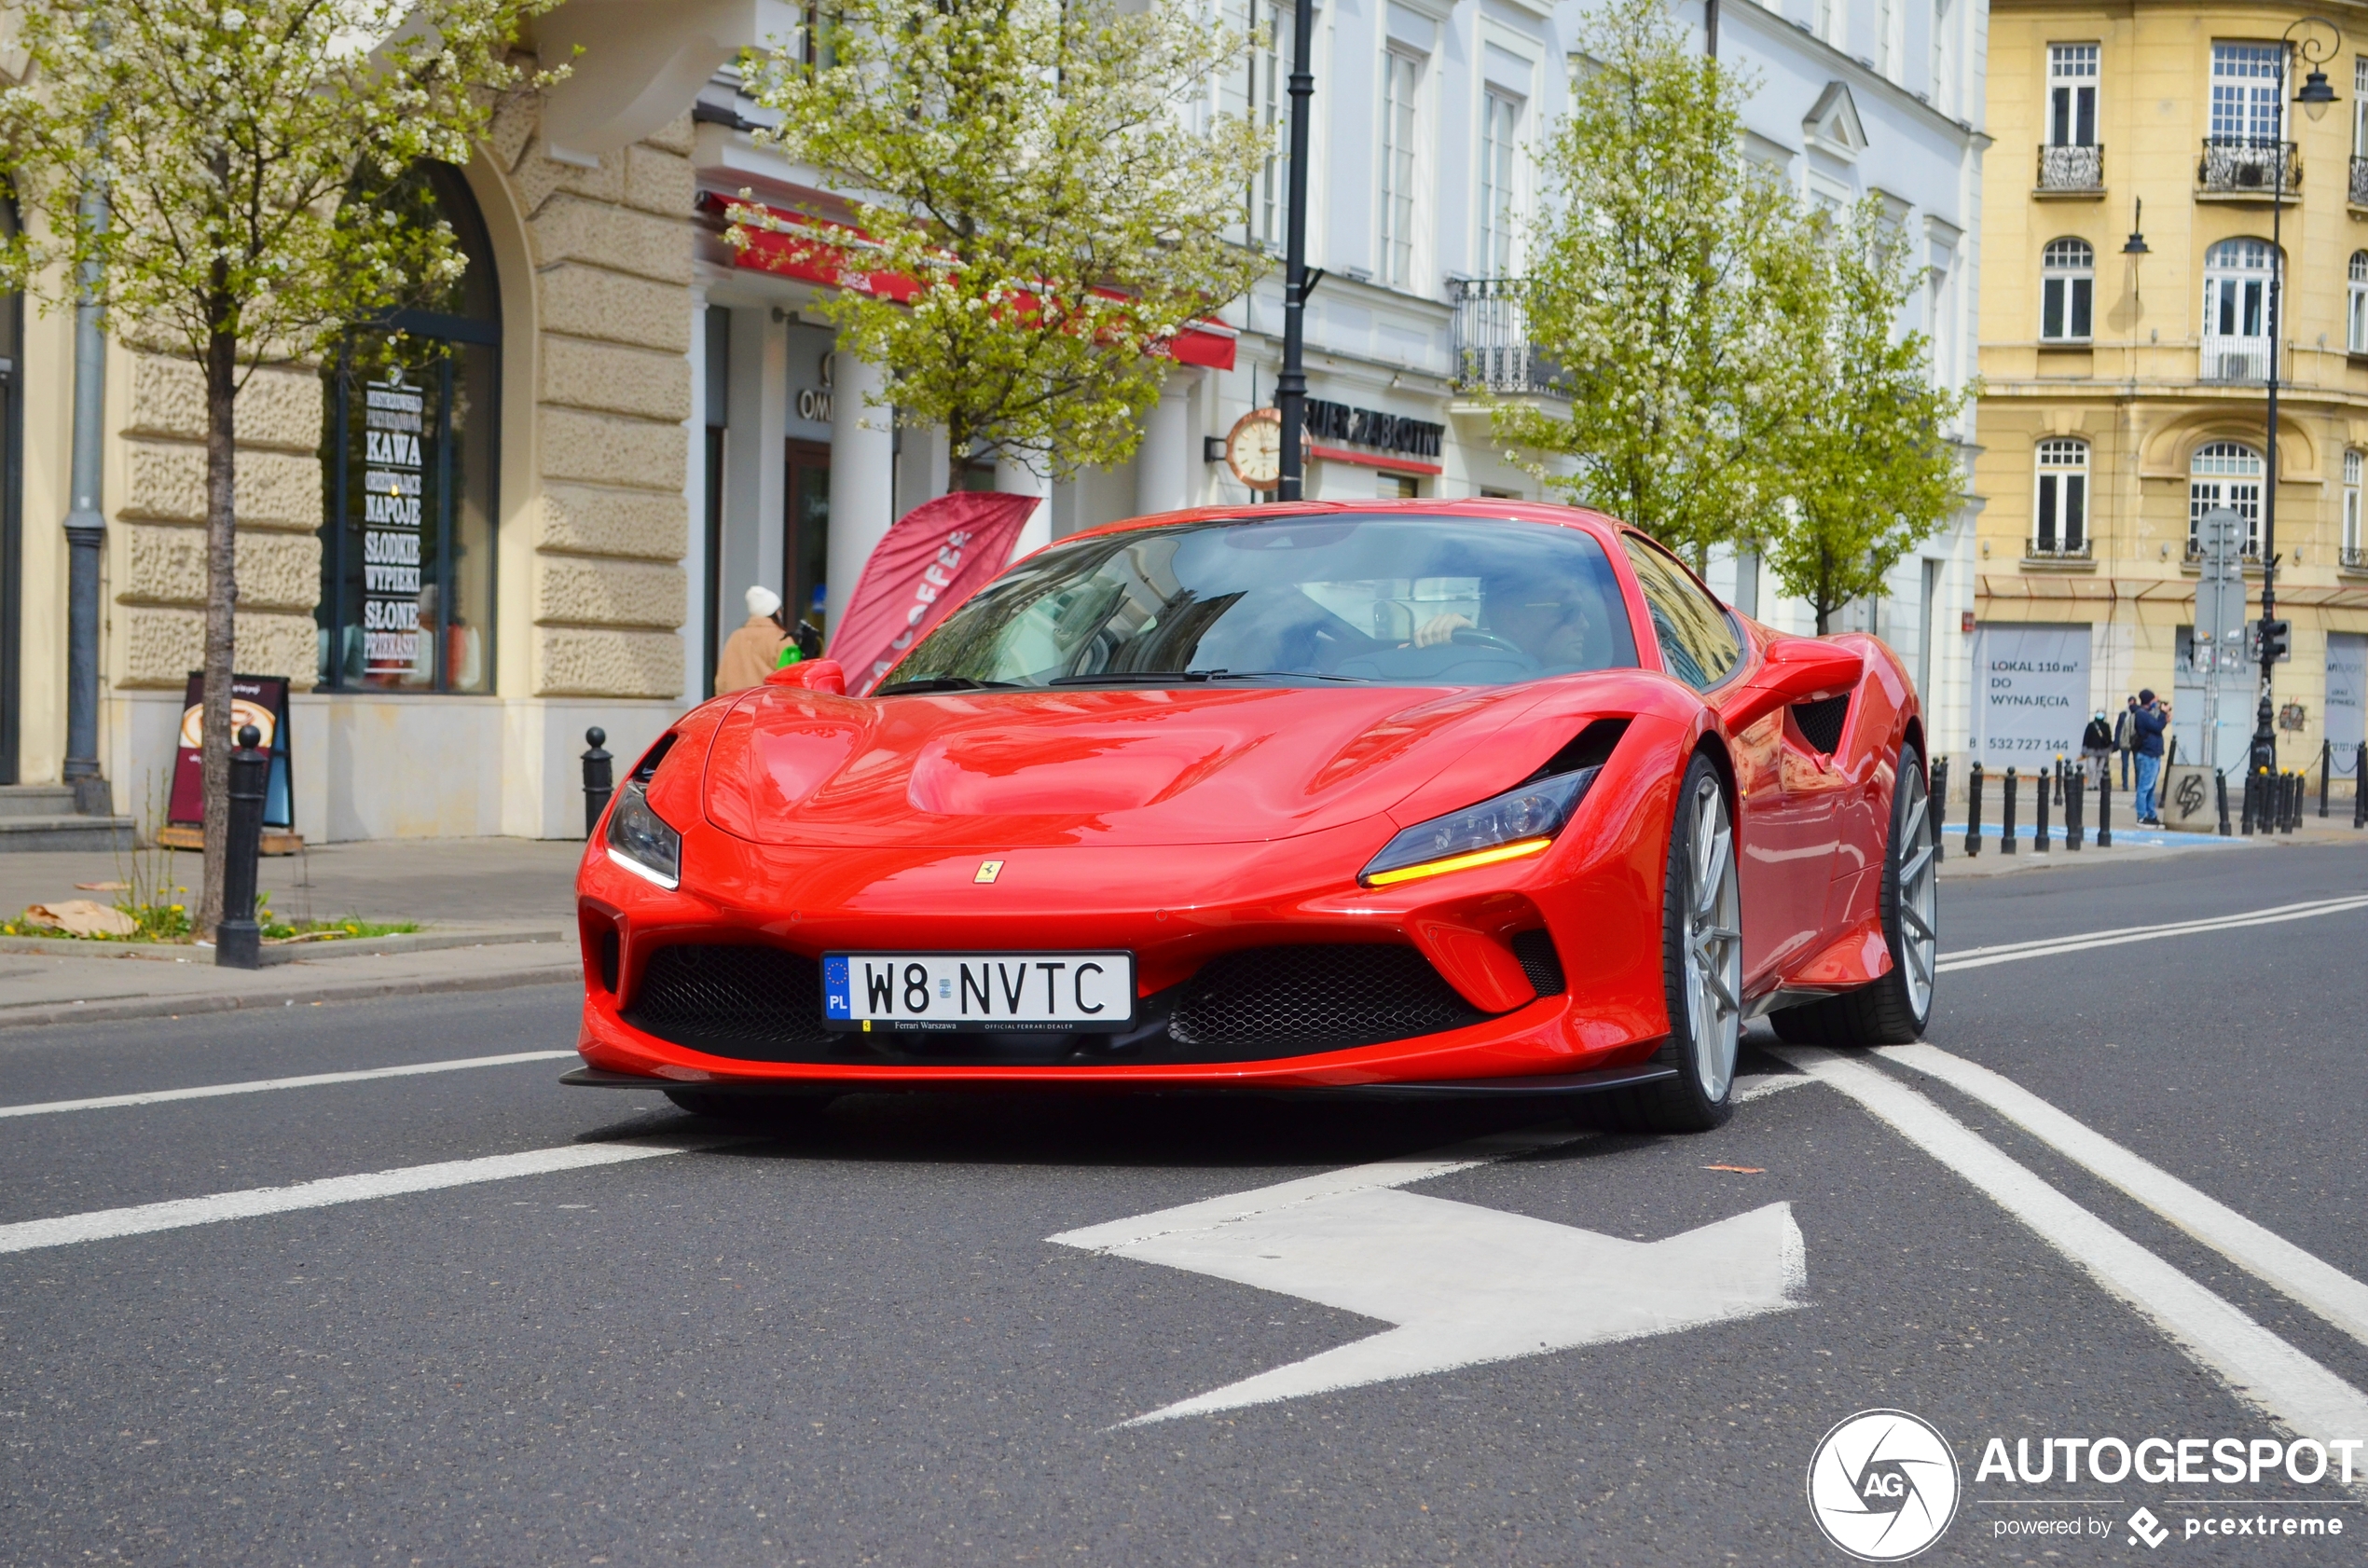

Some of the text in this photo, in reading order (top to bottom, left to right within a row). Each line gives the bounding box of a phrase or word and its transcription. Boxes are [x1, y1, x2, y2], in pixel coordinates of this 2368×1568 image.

[800, 389, 834, 421] OM
[365, 431, 422, 466] KAWA
[365, 494, 421, 527] NAPOJE
[365, 530, 421, 566] SŁODKIE
[364, 564, 421, 593] WYPIEKI
[891, 530, 972, 650] COFFEE
[364, 600, 420, 630] SŁONE
[1991, 660, 2034, 672] LOKAL
[2038, 662, 2060, 672] 110
[1990, 678, 2012, 689] DO
[1990, 695, 2070, 708] WYNAJĘCIA
[1989, 737, 2014, 750] 532
[2017, 738, 2042, 750] 727
[2045, 739, 2069, 751] 144
[829, 995, 847, 1010] PL
[865, 962, 1107, 1014] W8 NVTC
[894, 1021, 919, 1030] Ferrari
[920, 1021, 957, 1030] Warszawa
